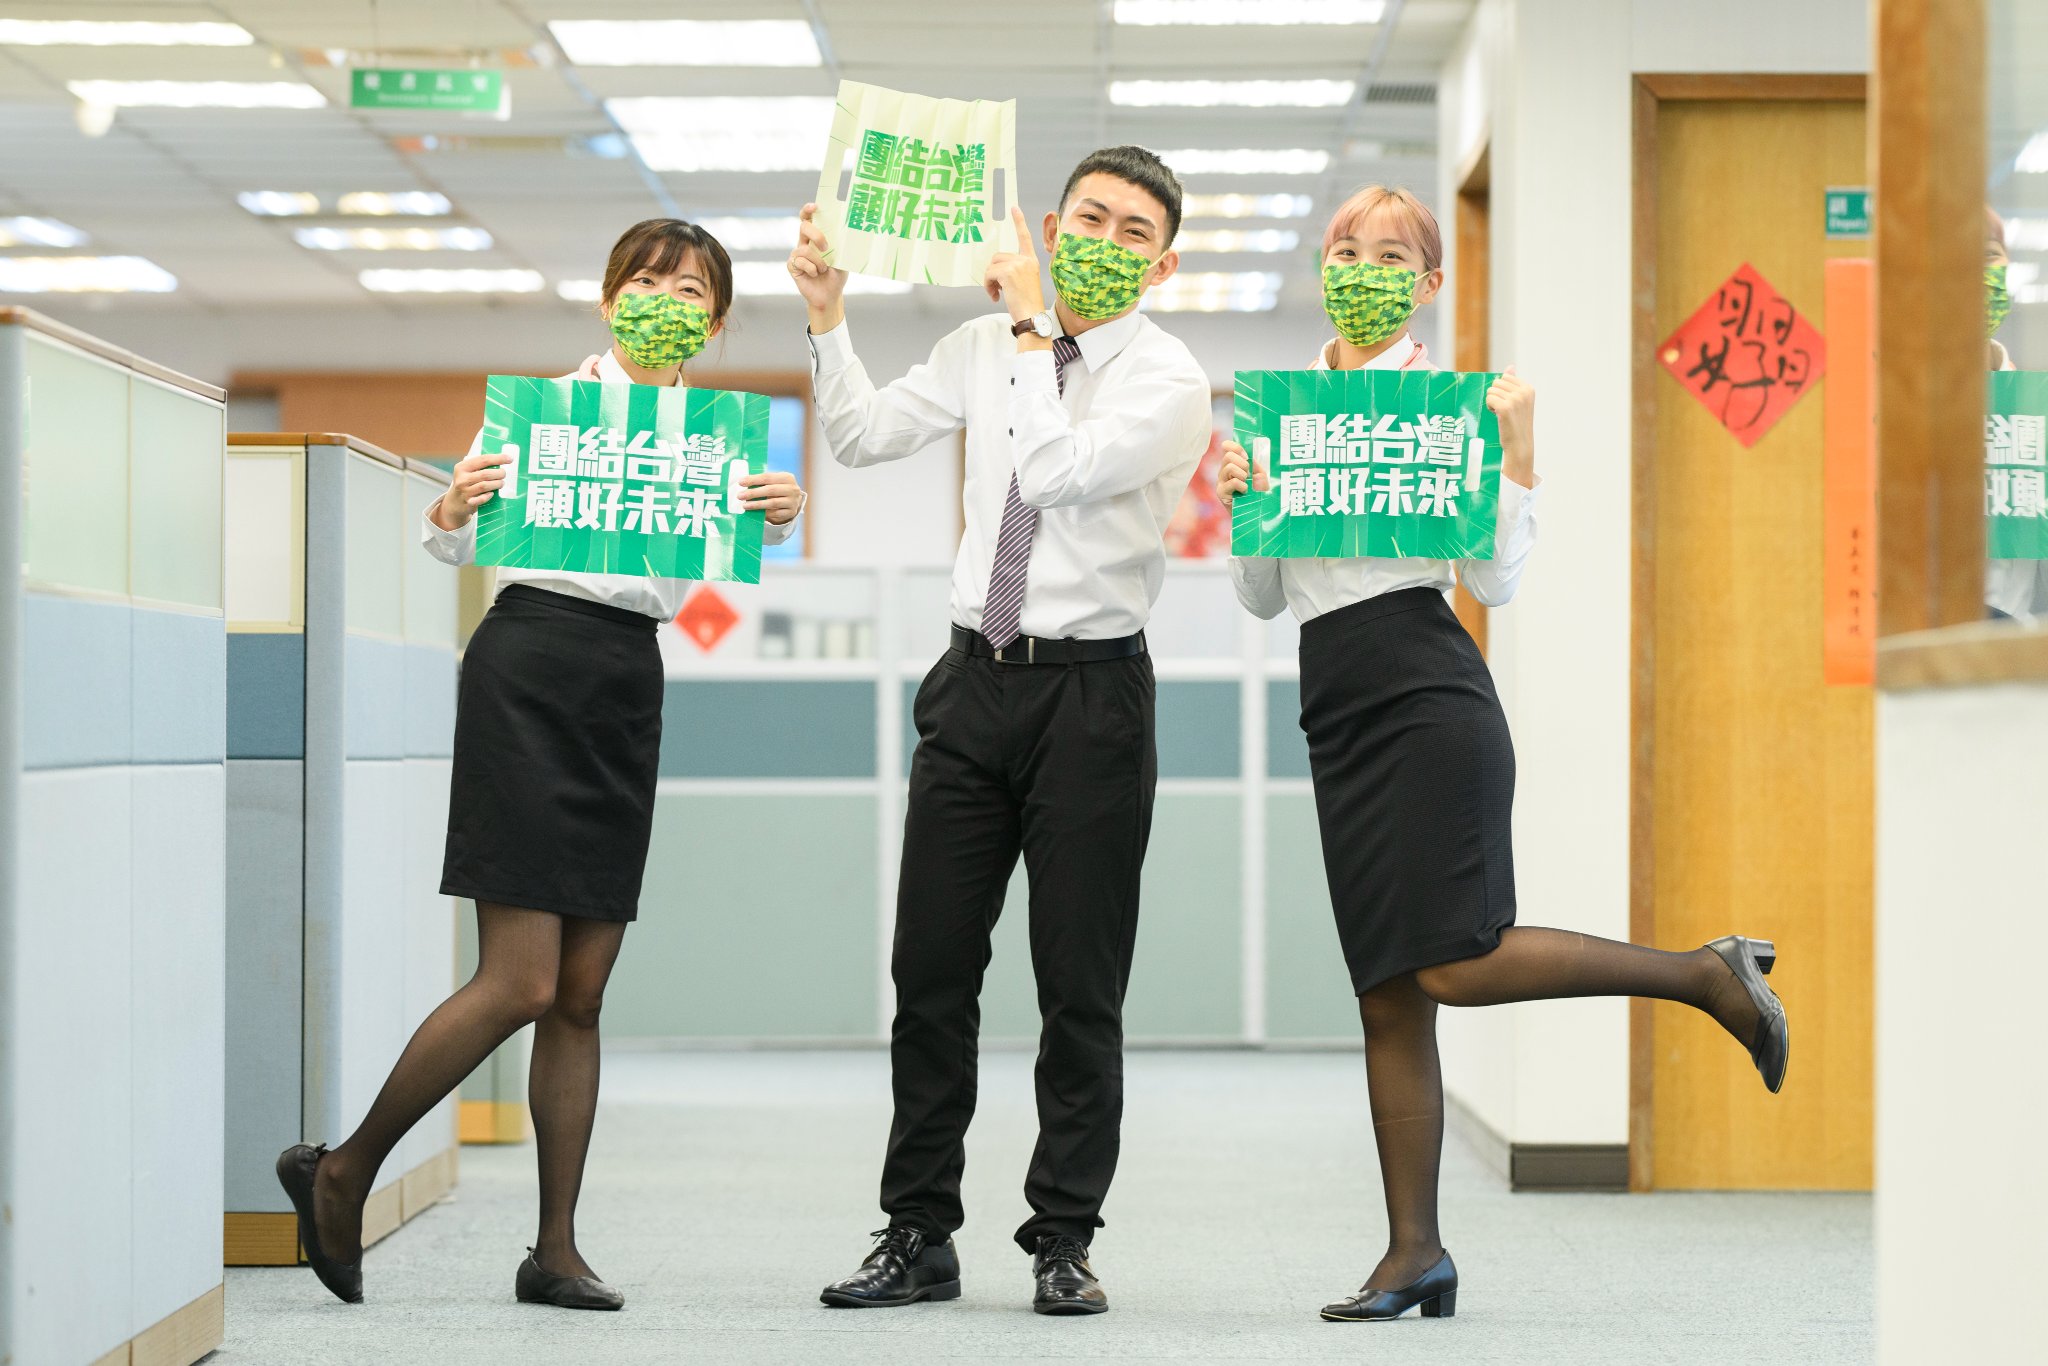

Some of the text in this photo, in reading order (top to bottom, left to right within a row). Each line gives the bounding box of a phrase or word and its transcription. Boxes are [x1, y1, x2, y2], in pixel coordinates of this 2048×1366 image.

[855, 129, 985, 193] 團結台灣
[845, 182, 985, 244] 顧好未來
[528, 423, 726, 486] 團結台灣
[1280, 413, 1466, 466] 團結台灣
[522, 478, 723, 539] 顧好未來
[1280, 467, 1463, 518] 顧好未來
